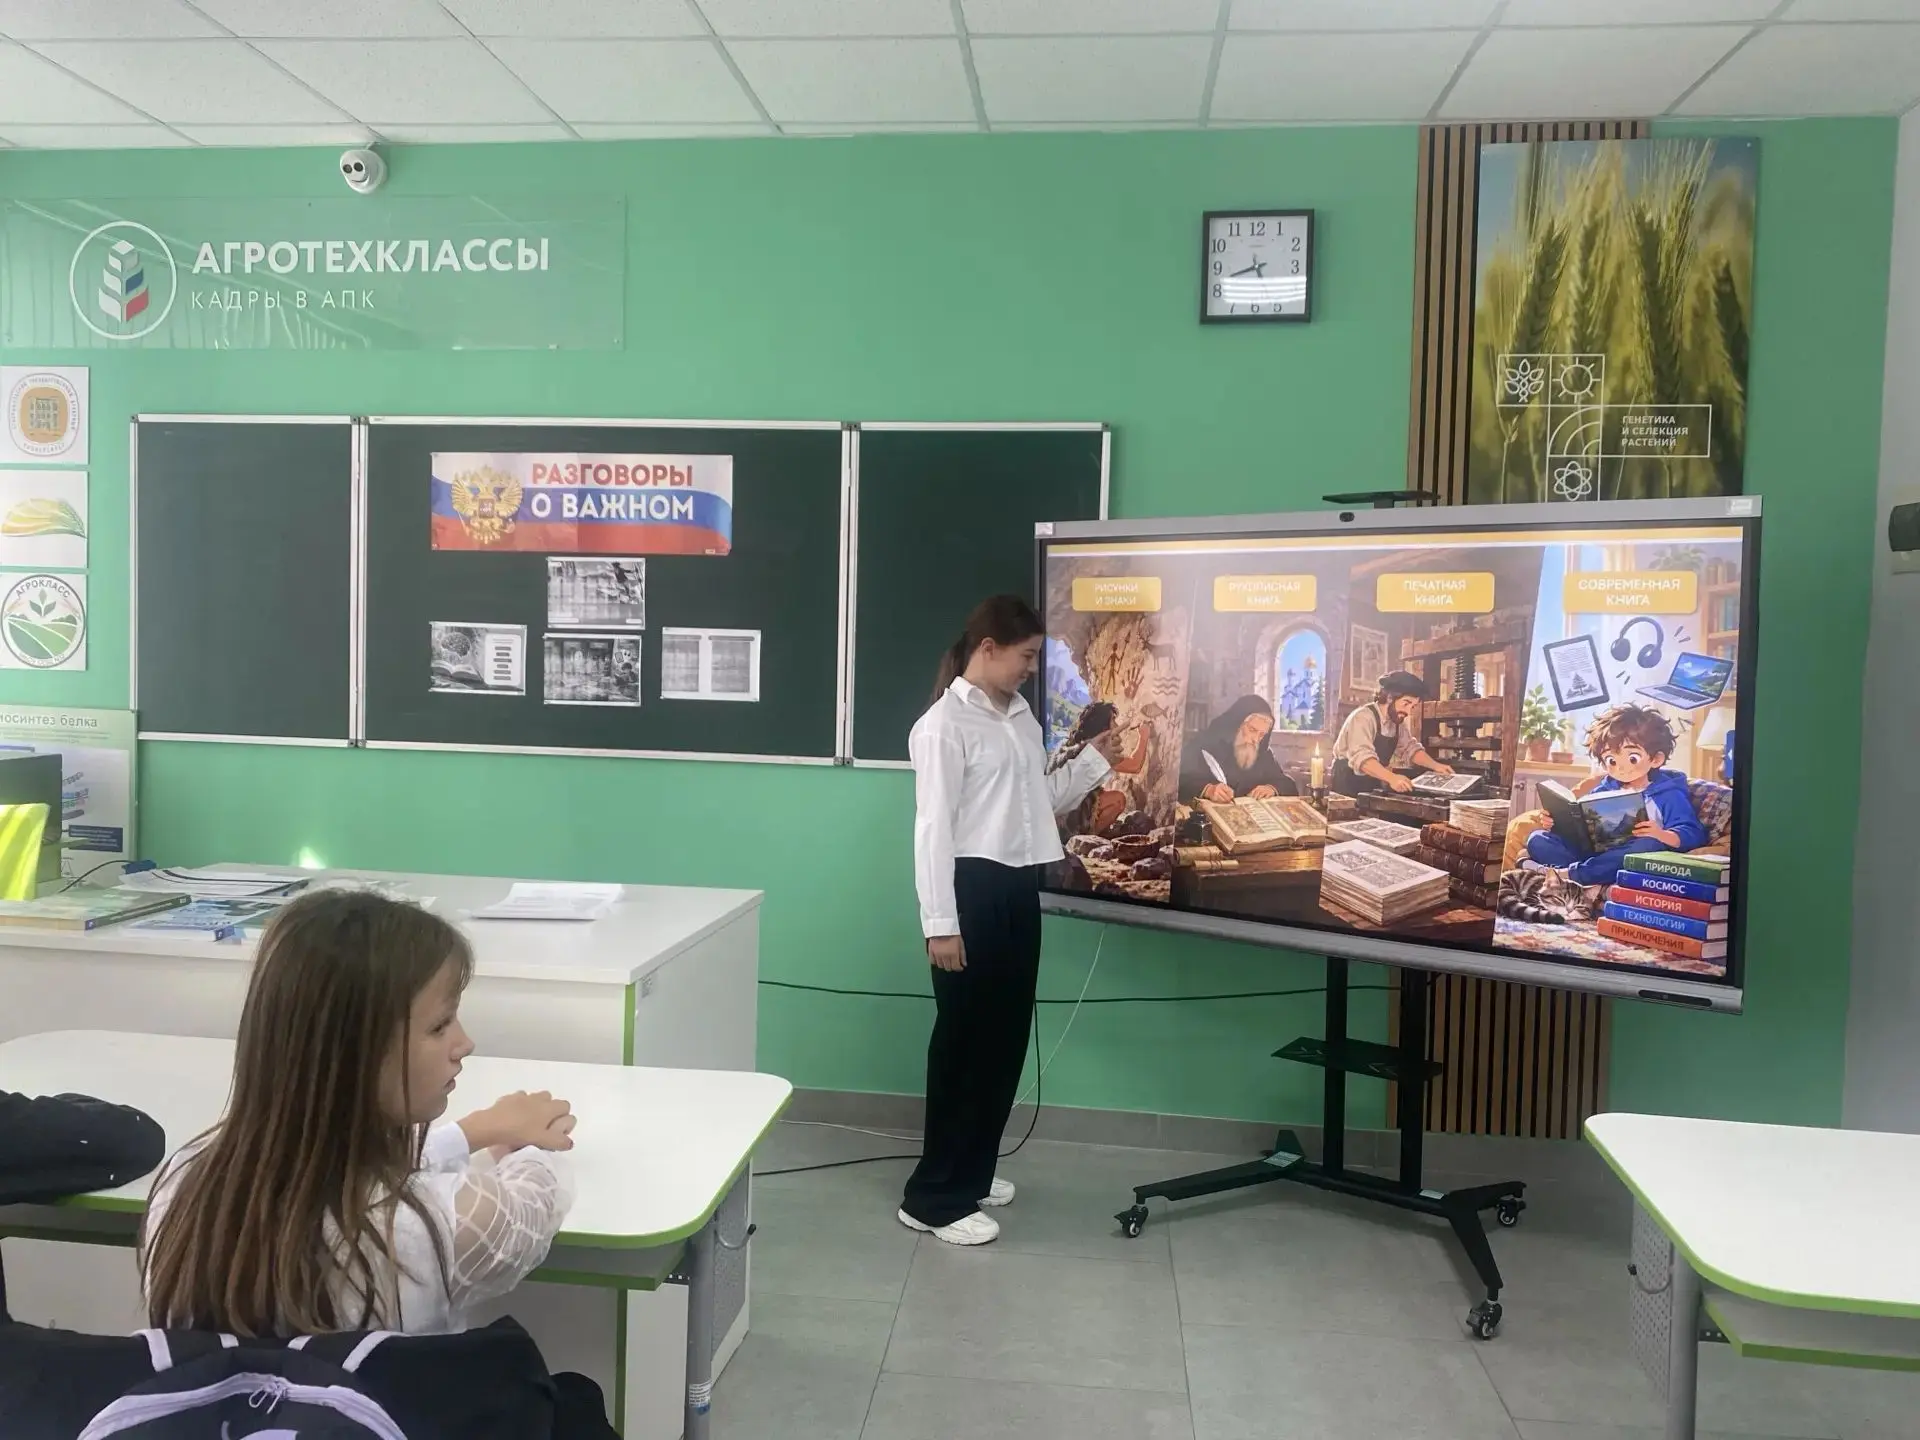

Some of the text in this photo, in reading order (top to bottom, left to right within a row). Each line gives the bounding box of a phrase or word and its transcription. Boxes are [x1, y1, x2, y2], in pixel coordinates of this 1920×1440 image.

[1228, 221, 1284, 237] 11 12 1
[1211, 238, 1226, 253] 10
[1291, 237, 1301, 252] 2
[192, 237, 550, 275] АГРОТЕХКЛАССЫ
[1213, 261, 1222, 276] 9
[1291, 259, 1300, 274] 3
[1212, 284, 1222, 298] 8
[191, 290, 375, 311] КАДРЫ В АПК
[1622, 415, 1676, 424] ГЕНЕТИКА
[1621, 427, 1689, 436] И СЕЛЕКЦИЯ
[1621, 436, 1677, 447] РАСТЕНИЙ
[532, 463, 693, 486] РАЗГОВОРЫ
[531, 492, 694, 521] О ВАЖНОМ
[15, 579, 71, 599] АГРОКЛАСС
[1404, 579, 1467, 591] ПЕЧАТНАЯ
[1578, 578, 1681, 591] СОВРЕМЕННАЯ
[1414, 594, 1454, 605] КНИГА
[1605, 594, 1651, 606] КНИГА
[60, 714, 98, 727] белка
[1645, 862, 1691, 876] ПРИРОДА
[1642, 879, 1685, 893] КОСМОС
[1635, 894, 1682, 912] ИСТОРИЯ
[1623, 910, 1685, 931] ТЕХНОЛОГИИ
[1611, 925, 1684, 950] ПРИКЛЮЧЕНИЯ
